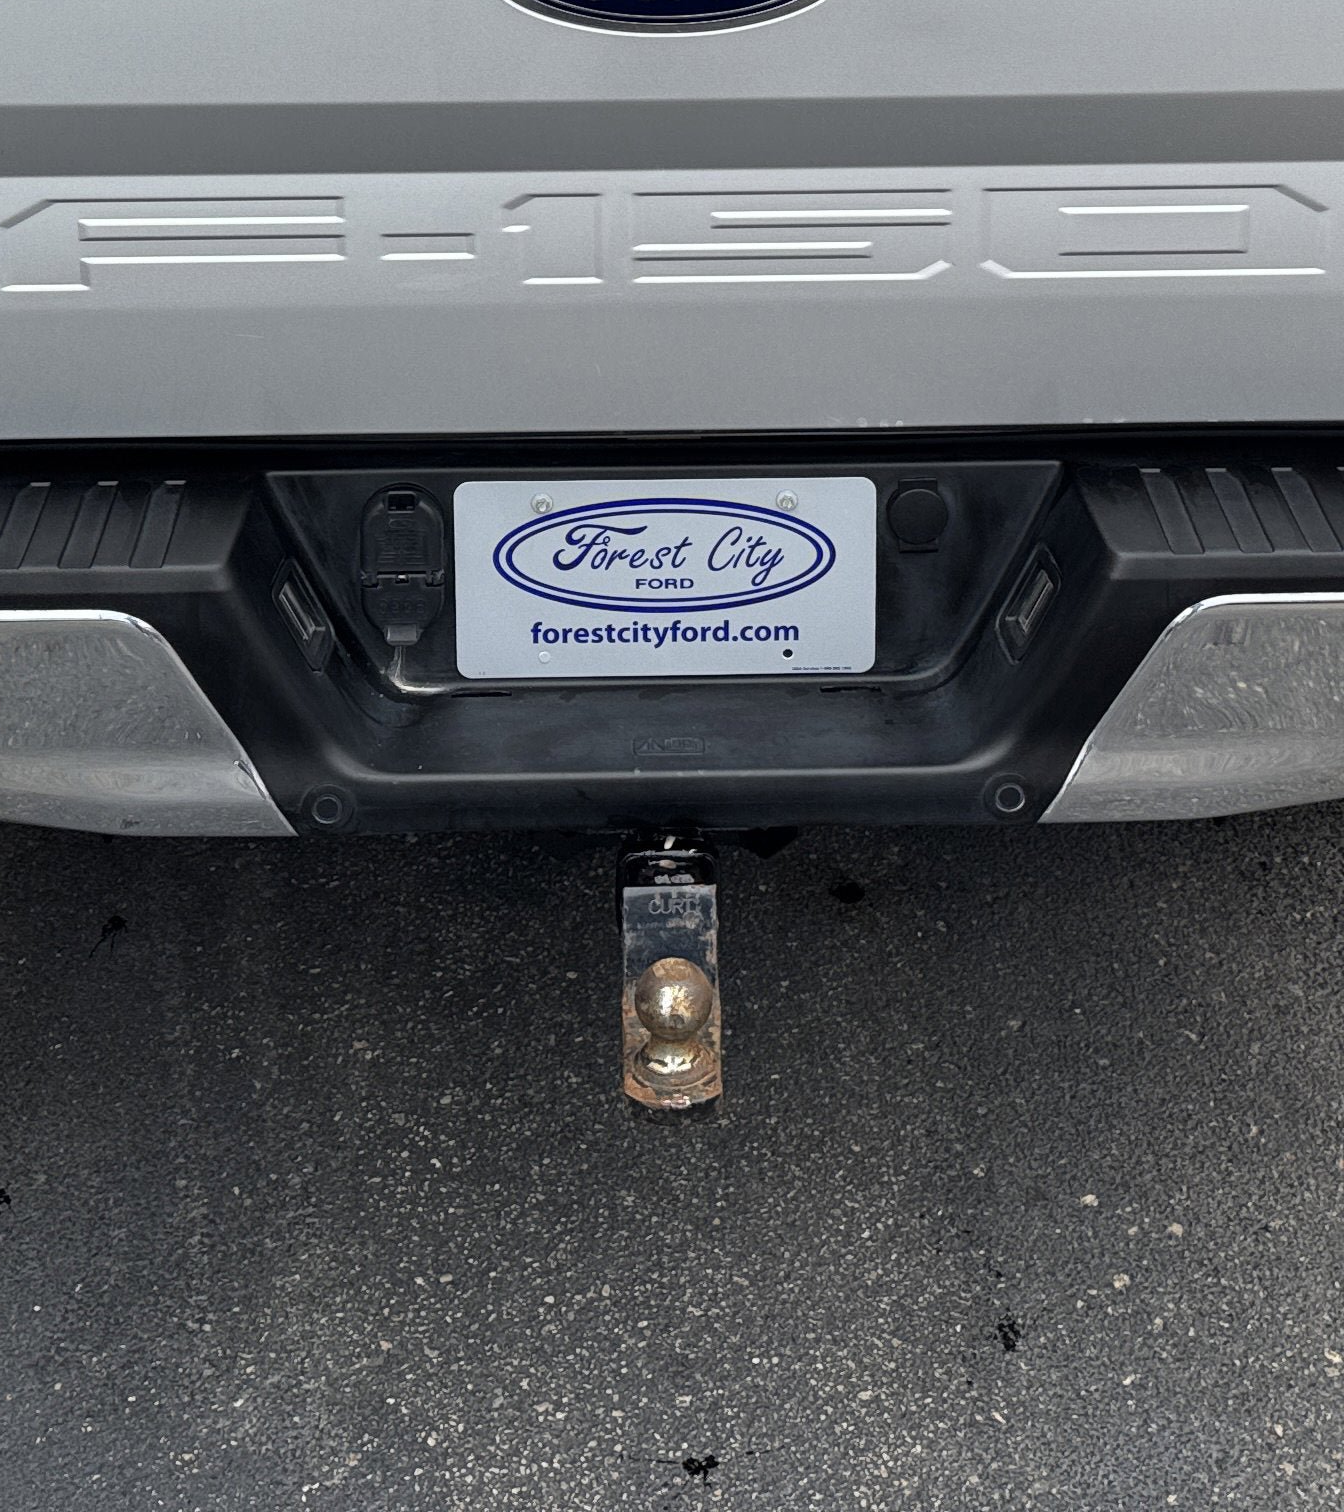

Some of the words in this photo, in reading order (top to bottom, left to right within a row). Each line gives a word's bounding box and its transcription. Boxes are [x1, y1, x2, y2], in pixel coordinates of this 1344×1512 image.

[552, 523, 693, 572] Forest
[707, 525, 785, 586] City
[635, 577, 694, 590] FORD
[530, 619, 800, 649] forestcityford.com
